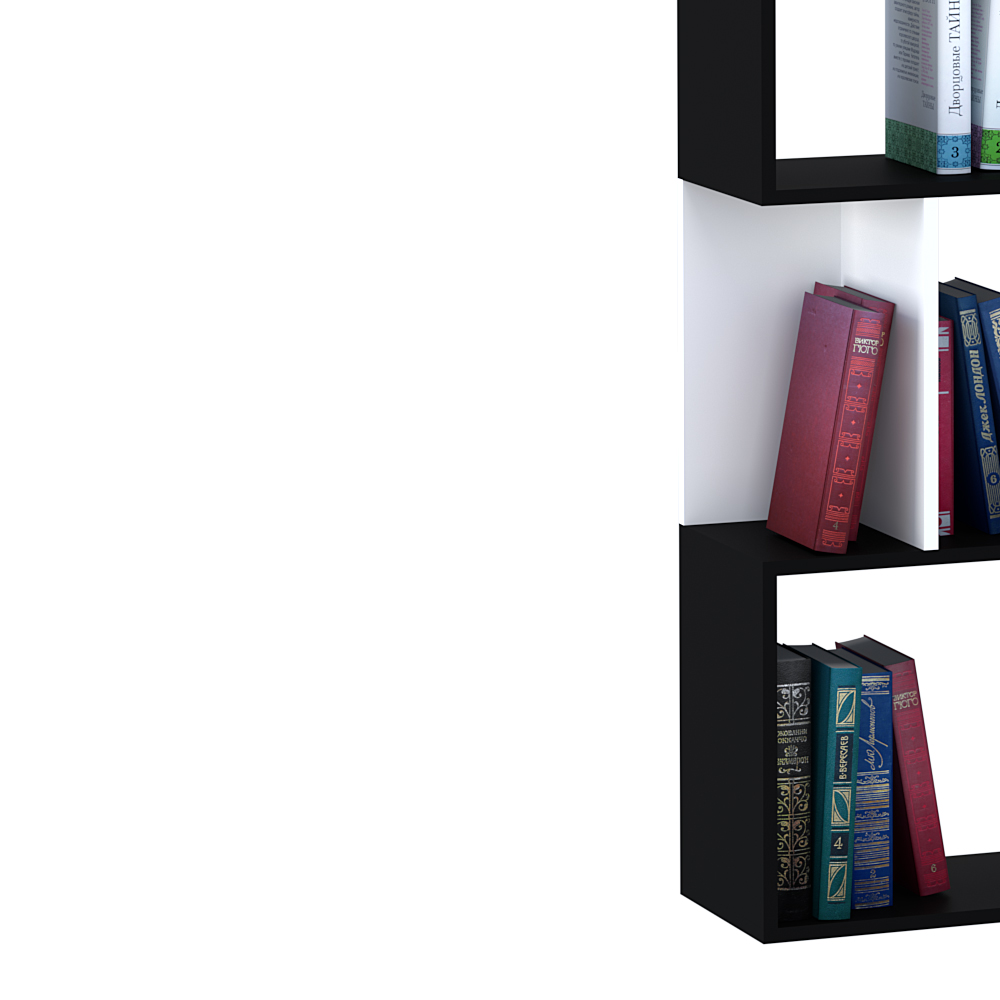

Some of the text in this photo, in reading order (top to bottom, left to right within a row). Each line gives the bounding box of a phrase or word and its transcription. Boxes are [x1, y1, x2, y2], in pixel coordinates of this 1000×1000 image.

[948, 45, 964, 117] Дворцовые
[951, 146, 960, 159] 3
[854, 337, 880, 347] ВИКТОР
[852, 343, 879, 356] ГЮГО
[968, 349, 994, 443] Джек ЛОНДОН
[989, 474, 998, 485] 6
[833, 521, 840, 531] 4
[893, 697, 919, 711] ГЮГО
[833, 836, 844, 850] 4
[930, 863, 938, 873] 6
